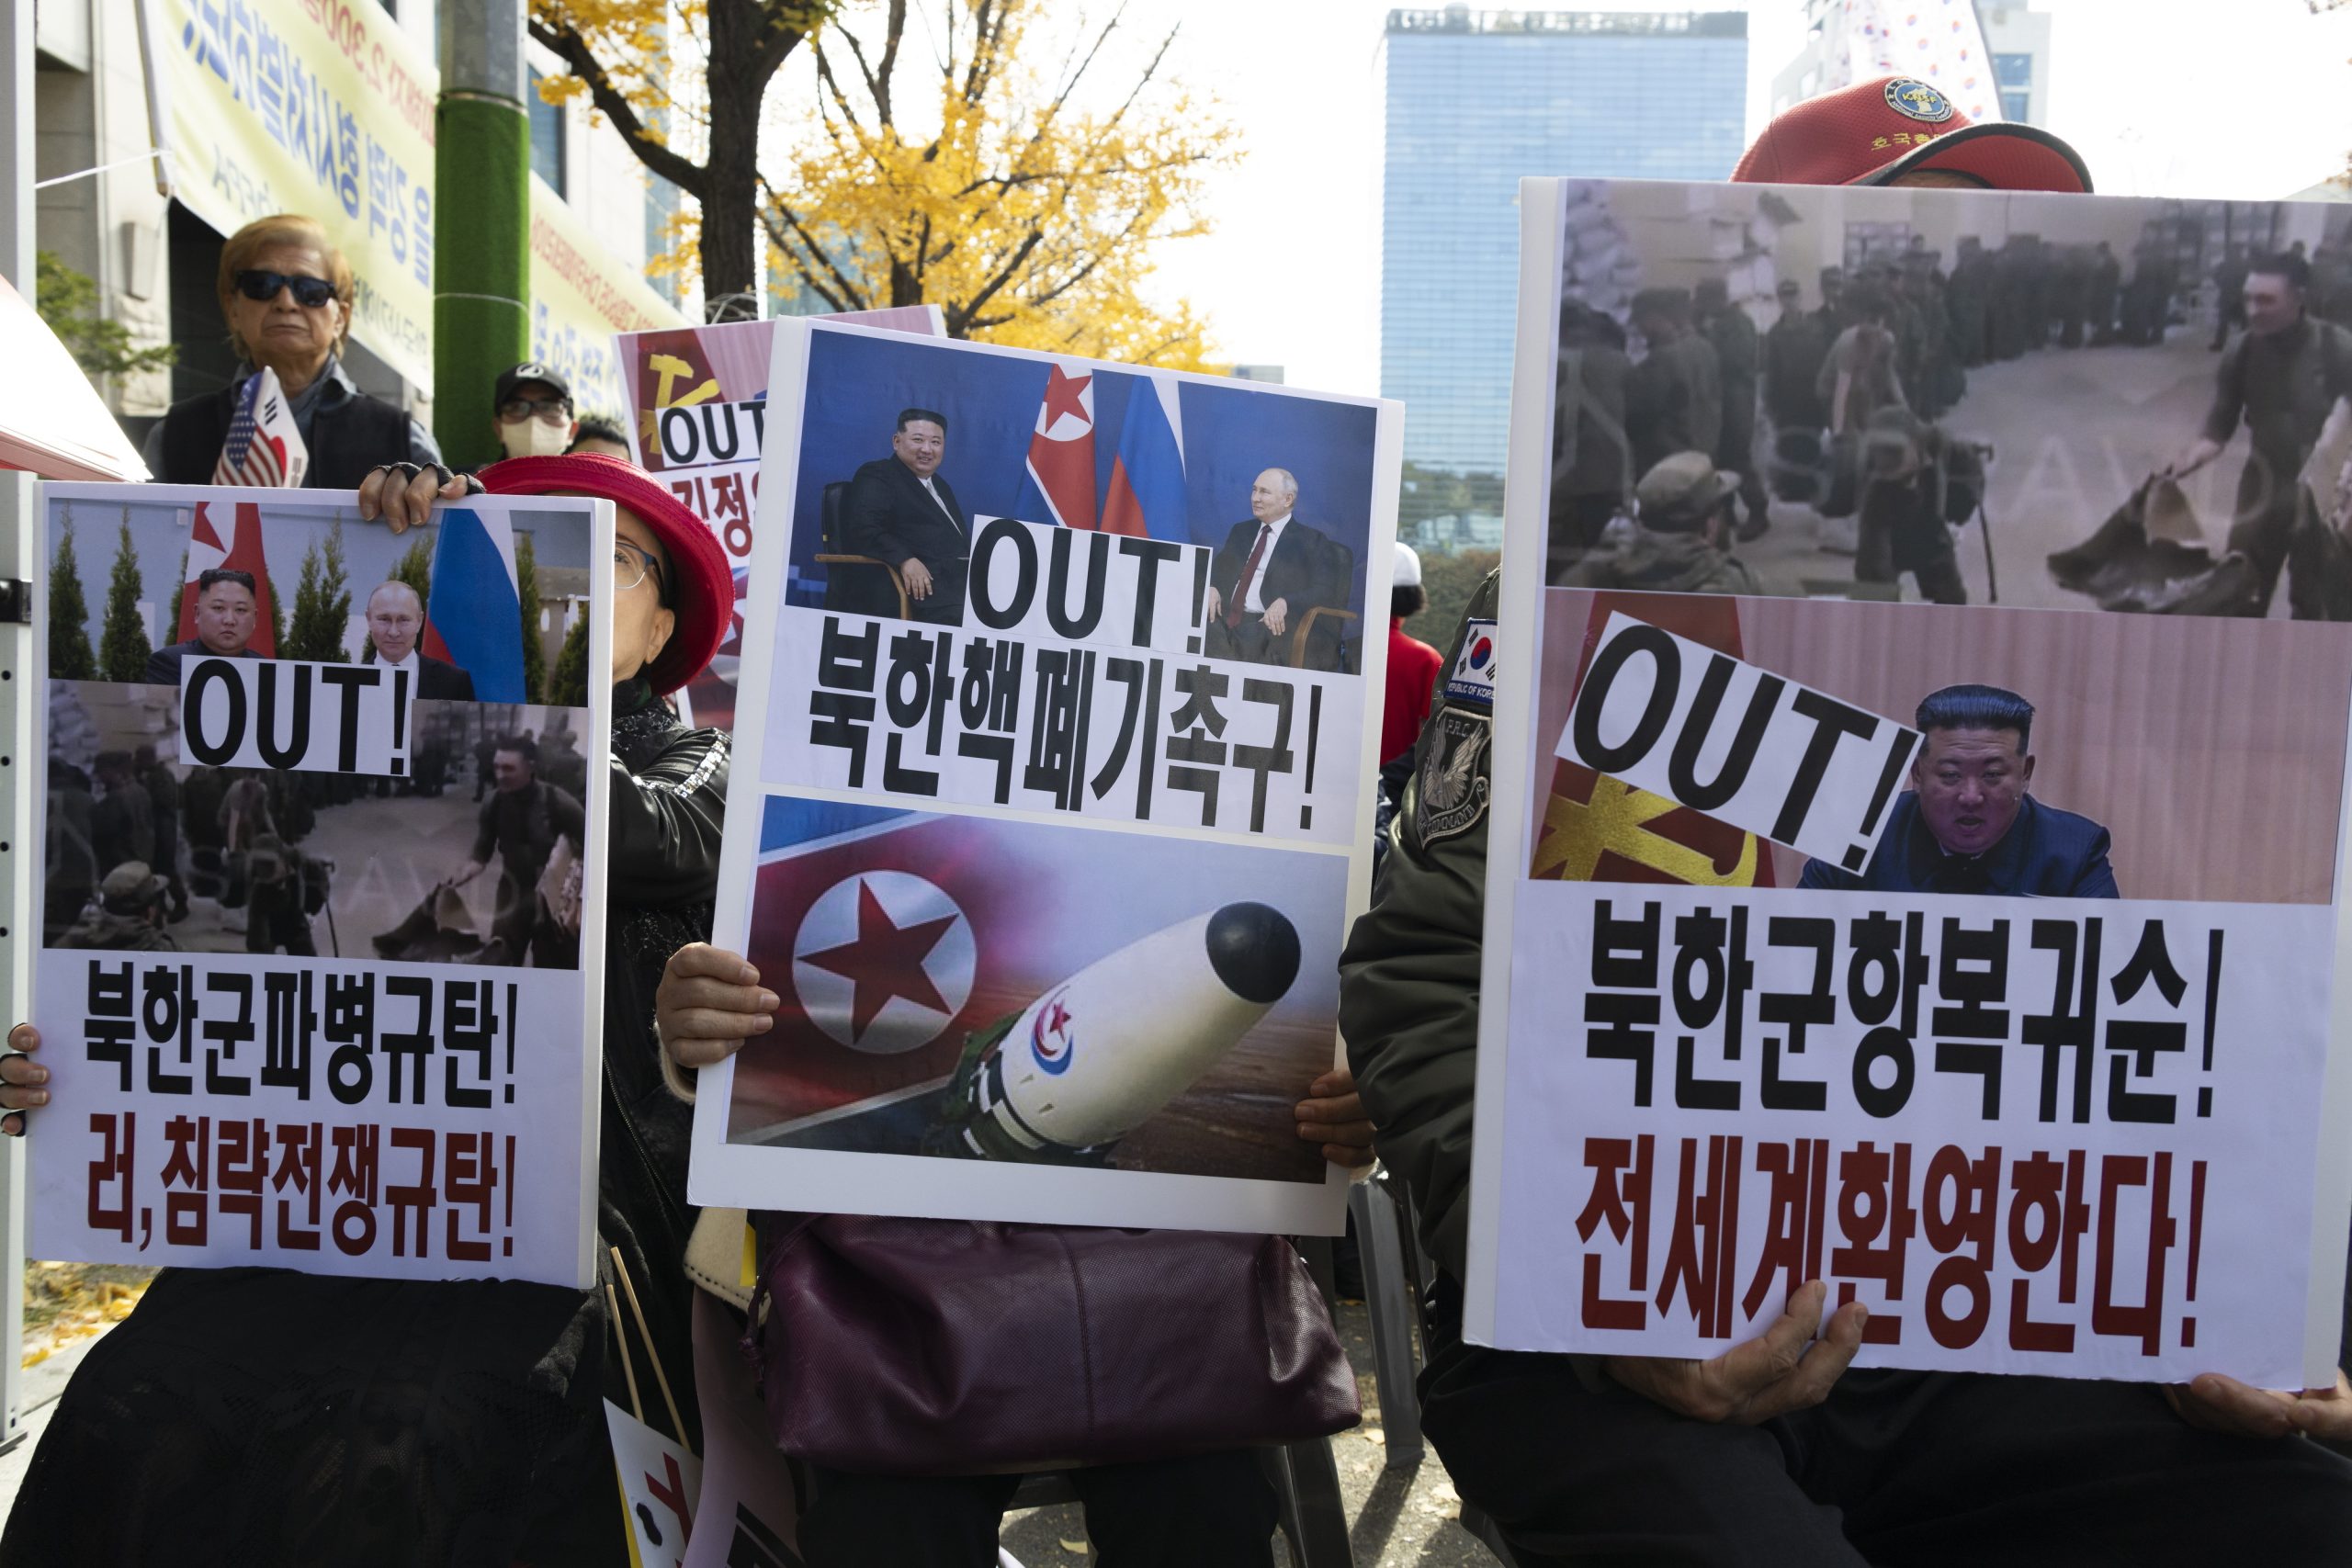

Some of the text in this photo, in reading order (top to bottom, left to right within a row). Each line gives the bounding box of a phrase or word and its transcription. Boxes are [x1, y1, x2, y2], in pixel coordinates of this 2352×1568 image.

[969, 520, 1213, 656] OUT!
[184, 659, 410, 776] OUT!
[809, 615, 1323, 832] 북한핵폐기촉구!
[1468, 685, 1478, 695] OF
[1574, 625, 1919, 870] OUT!
[84, 960, 517, 1110] 북한군파병규탄!
[1584, 899, 2224, 1125] 북한군항복귀순!
[87, 1111, 516, 1263] 러,침략전쟁규탄!
[1575, 1134, 2208, 1357] 전세계환영한다!
